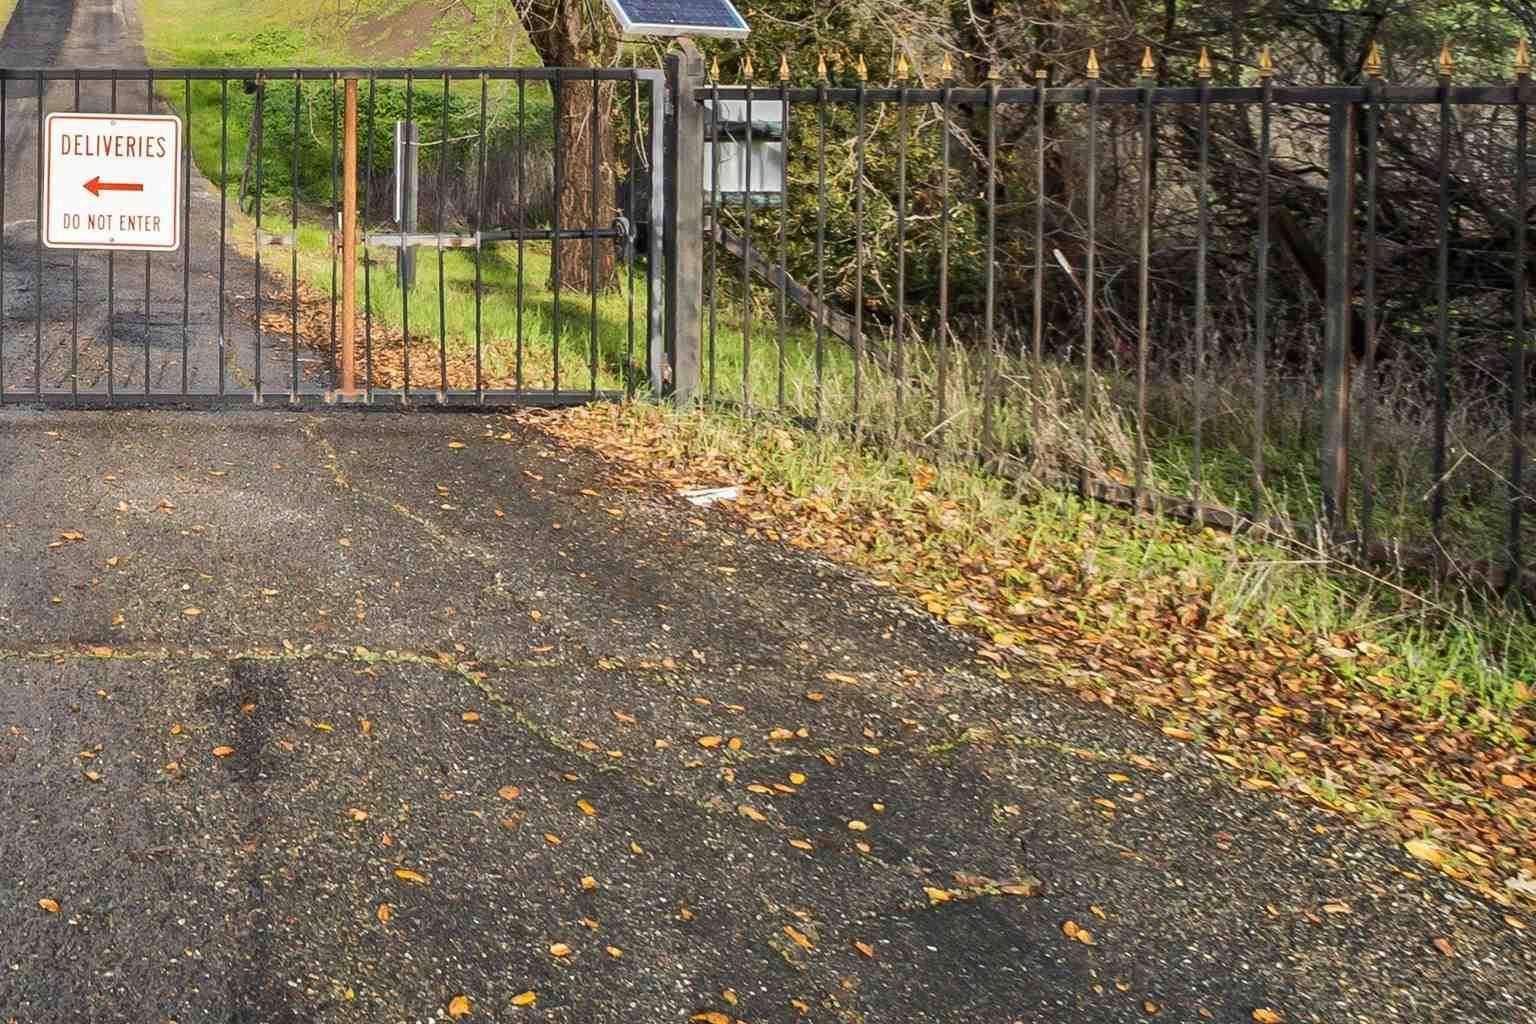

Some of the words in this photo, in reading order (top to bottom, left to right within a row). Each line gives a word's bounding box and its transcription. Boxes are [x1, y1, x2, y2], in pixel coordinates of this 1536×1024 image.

[61, 134, 166, 158] DELIVERIES
[64, 213, 80, 230] DO
[88, 214, 113, 231] NOT
[120, 215, 161, 232] ENTER
